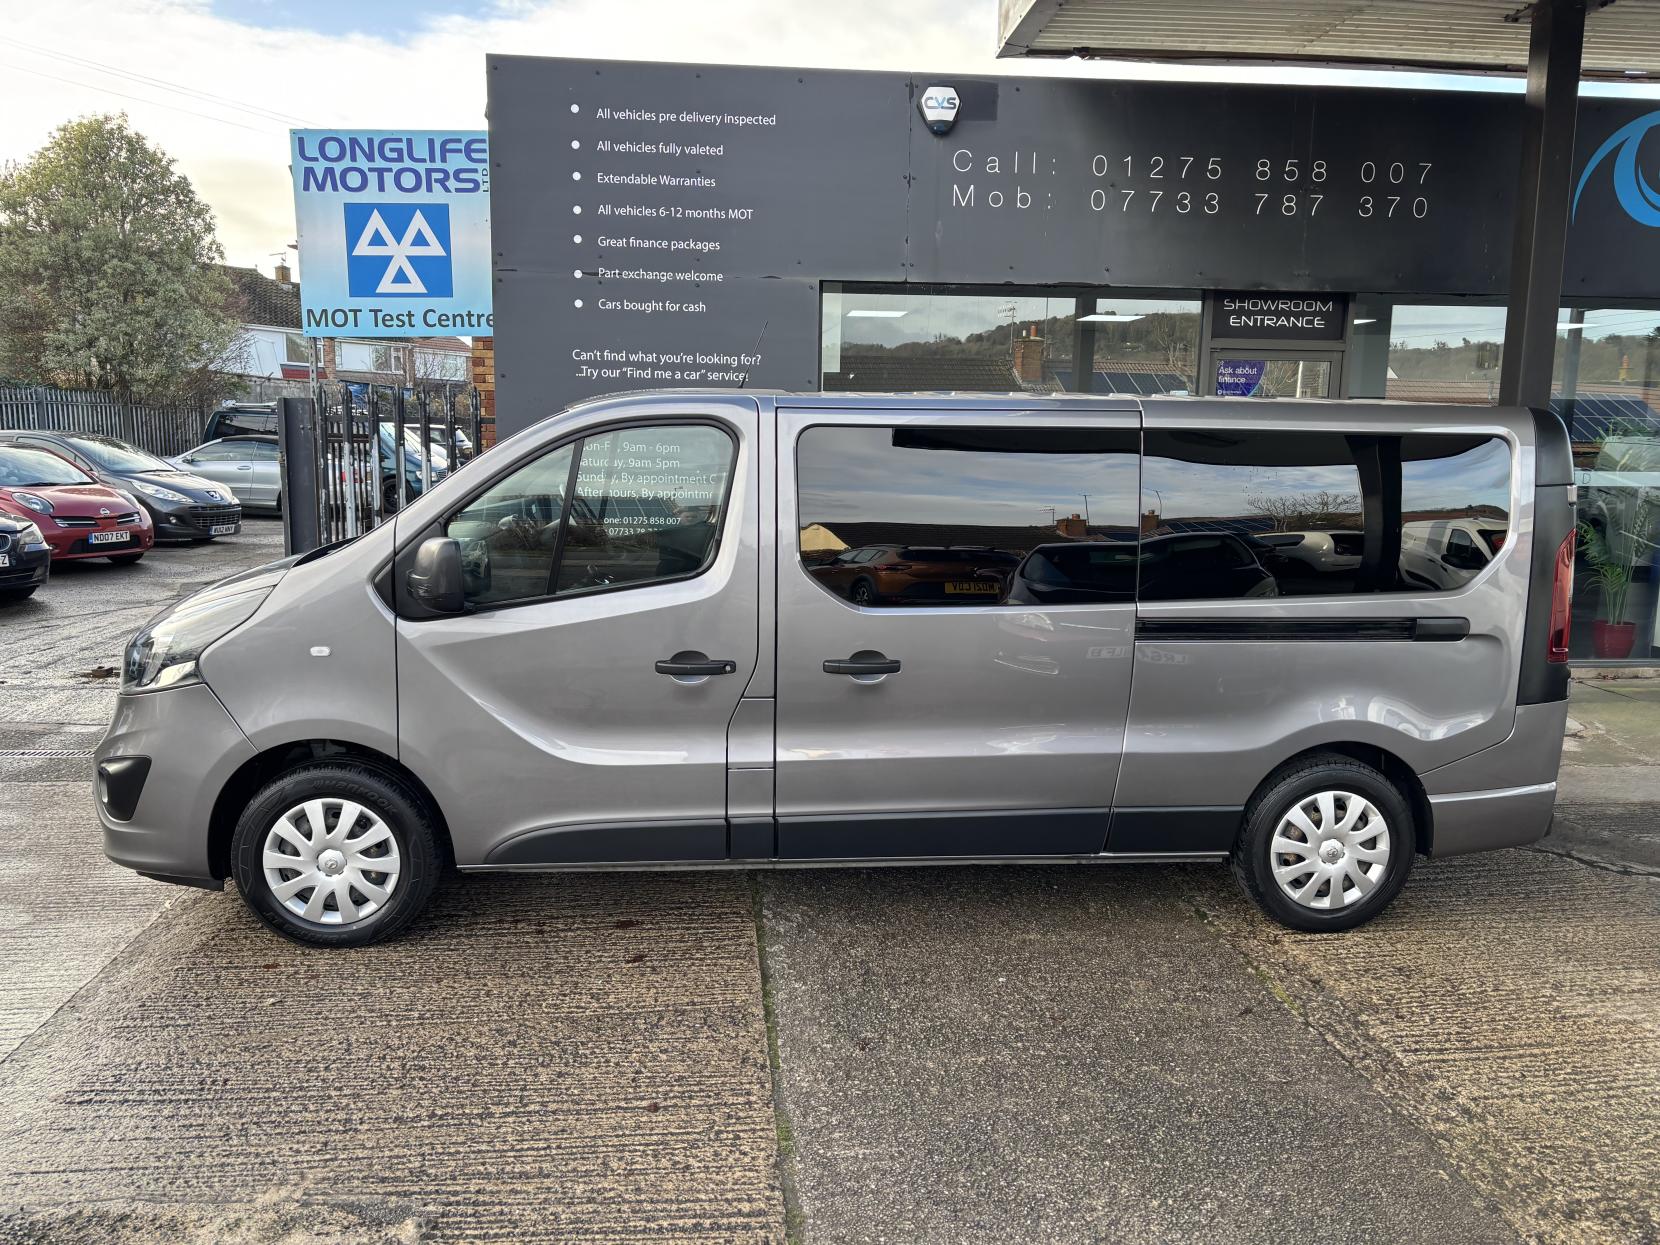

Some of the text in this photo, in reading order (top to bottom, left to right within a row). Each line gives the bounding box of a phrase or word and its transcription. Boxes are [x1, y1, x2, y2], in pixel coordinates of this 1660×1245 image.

[924, 97, 957, 109] CVS
[597, 108, 776, 127] All vehicles pre delivery inspected
[297, 136, 488, 164] LONGLIFE
[597, 140, 724, 156] All vehicles fully valeted
[953, 149, 1433, 185] Call: 01275 858 007
[302, 166, 481, 193] MOTORS
[481, 167, 490, 193] LTD
[597, 172, 716, 187] Extendable Warranties
[953, 183, 1428, 218] Mob: 07733 787 370
[598, 205, 754, 220] All vehicles 6-12 months MOT
[598, 236, 721, 252] Great finance packages
[598, 268, 724, 283] Part exchange welcome
[598, 299, 706, 313] Cars bought for cash
[1223, 299, 1333, 312] SHOWROOM
[306, 308, 494, 328] MOT Test Centre
[1229, 315, 1326, 328] ENTRANCE
[572, 349, 762, 367] Can't find what you're looking for?
[601, 369, 620, 378] our
[622, 367, 651, 379] "Find
[654, 370, 672, 379] me
[674, 371, 681, 379] a
[683, 369, 706, 380] car"
[1218, 366, 1258, 375] Ask about
[623, 441, 647, 452] 9am
[655, 442, 681, 454] 6pm
[628, 458, 652, 468] 9am
[655, 458, 681, 470] 5pm
[621, 472, 635, 485] By
[637, 473, 707, 486] appointment
[577, 487, 603, 498] After
[641, 488, 655, 501] By
[657, 488, 713, 500] appointm
[603, 517, 622, 525] one:
[623, 516, 648, 525] 01275
[649, 517, 665, 525] 858
[115, 531, 129, 541] EKT
